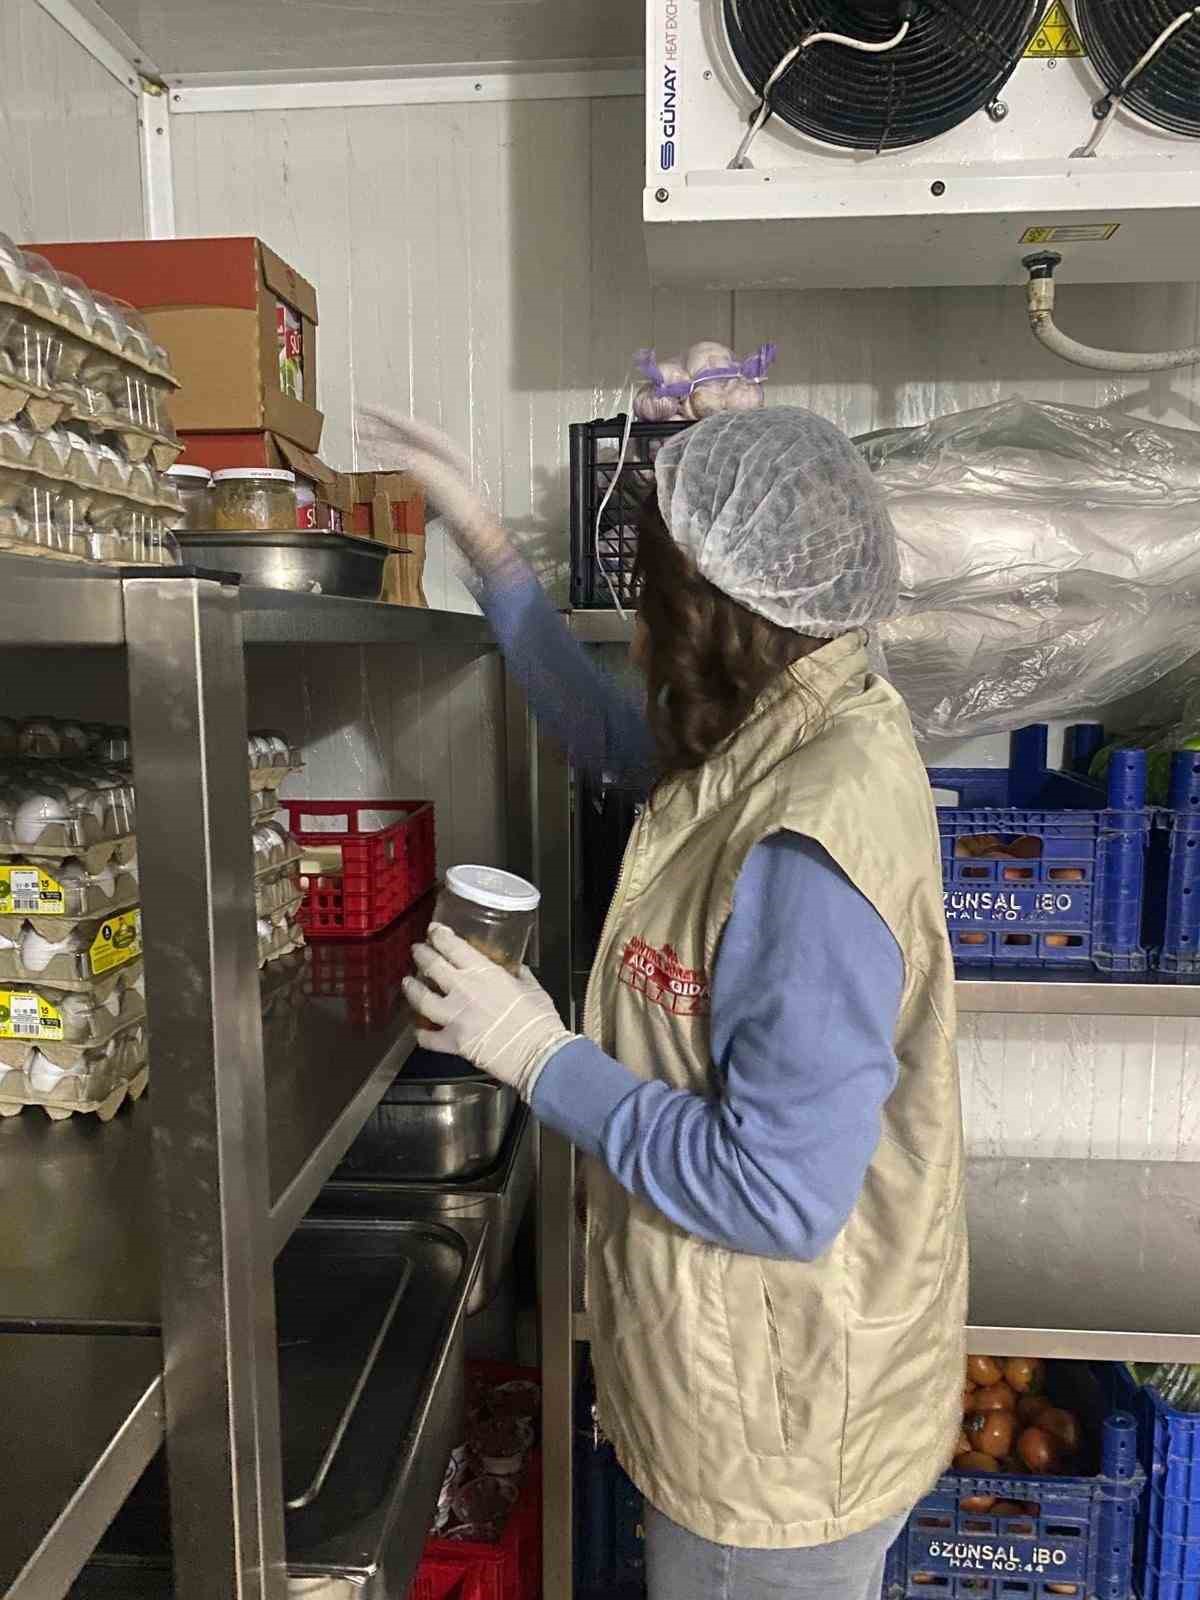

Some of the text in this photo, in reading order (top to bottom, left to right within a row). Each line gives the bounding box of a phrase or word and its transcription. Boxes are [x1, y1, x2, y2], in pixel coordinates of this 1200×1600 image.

[665, 32, 677, 60] HEAT
[660, 65, 676, 137] GÜNAY
[929, 1541, 1021, 1562] ÖZÜNSAL
[949, 1558, 1044, 1574] HAL NO:44
